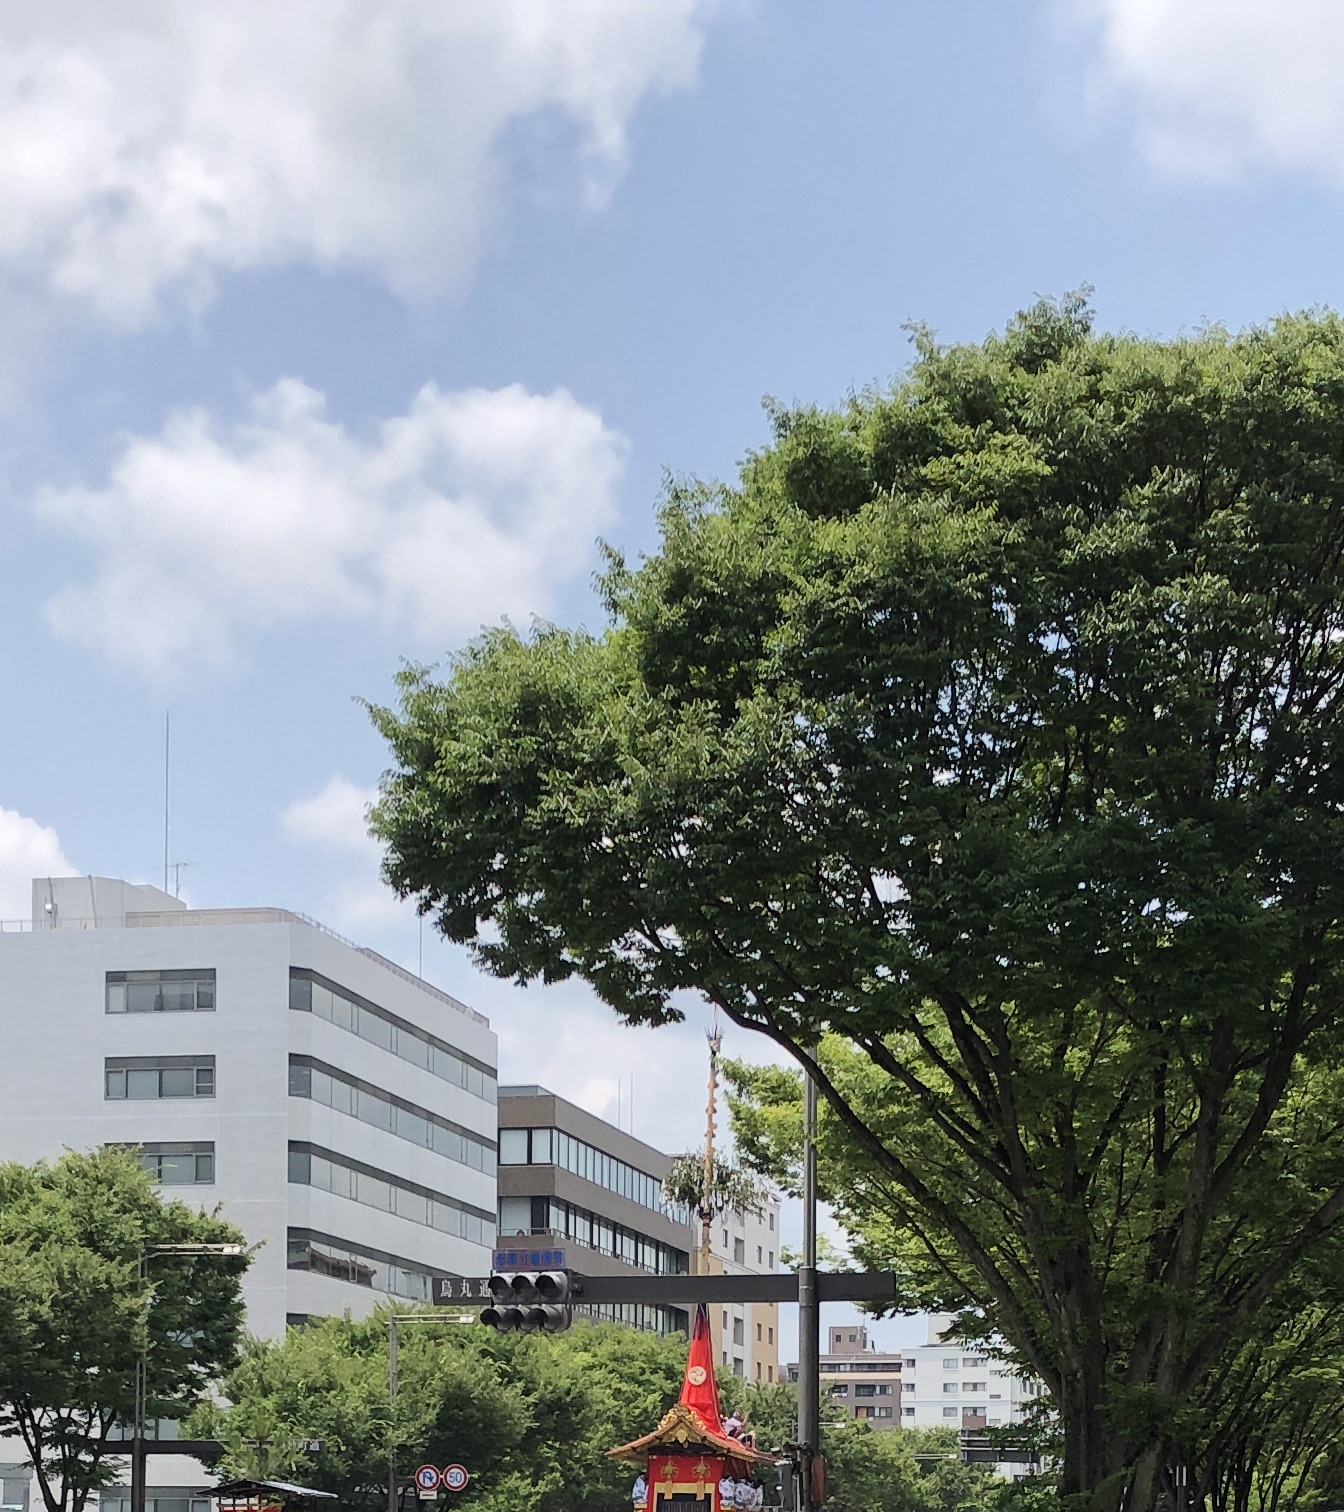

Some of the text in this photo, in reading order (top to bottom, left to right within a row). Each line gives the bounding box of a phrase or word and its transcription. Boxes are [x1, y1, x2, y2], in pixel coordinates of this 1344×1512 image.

[440, 1278, 492, 1299] 烏丸通
[449, 1471, 463, 1484] 50
